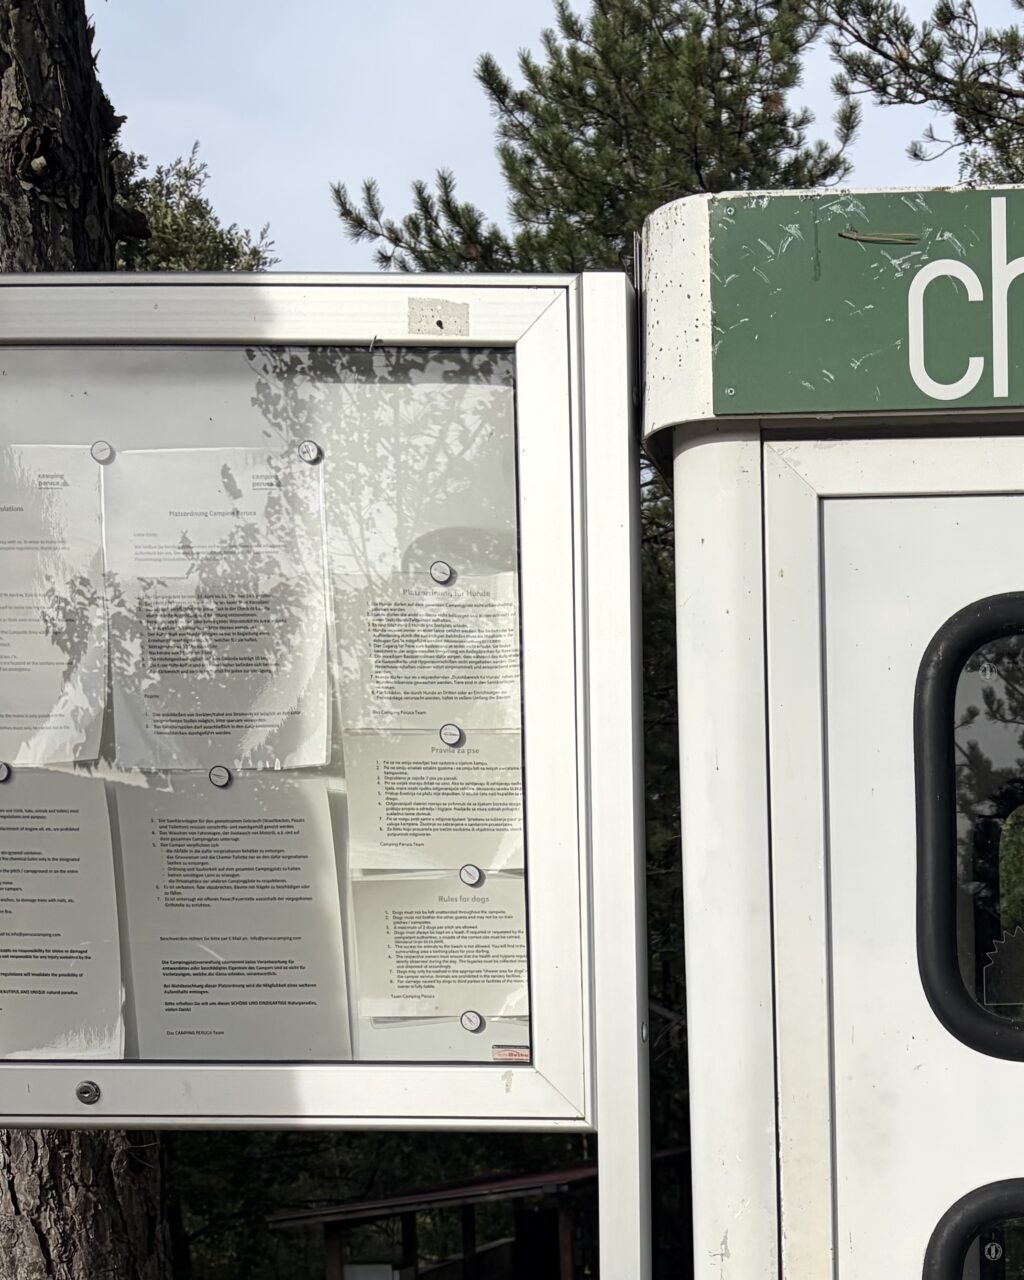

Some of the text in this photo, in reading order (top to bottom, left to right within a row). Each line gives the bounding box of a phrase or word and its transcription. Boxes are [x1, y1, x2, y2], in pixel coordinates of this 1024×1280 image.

[466, 589, 491, 597] Hunde
[431, 746, 456, 754] Pravila
[438, 895, 490, 904] Rules for dogs
